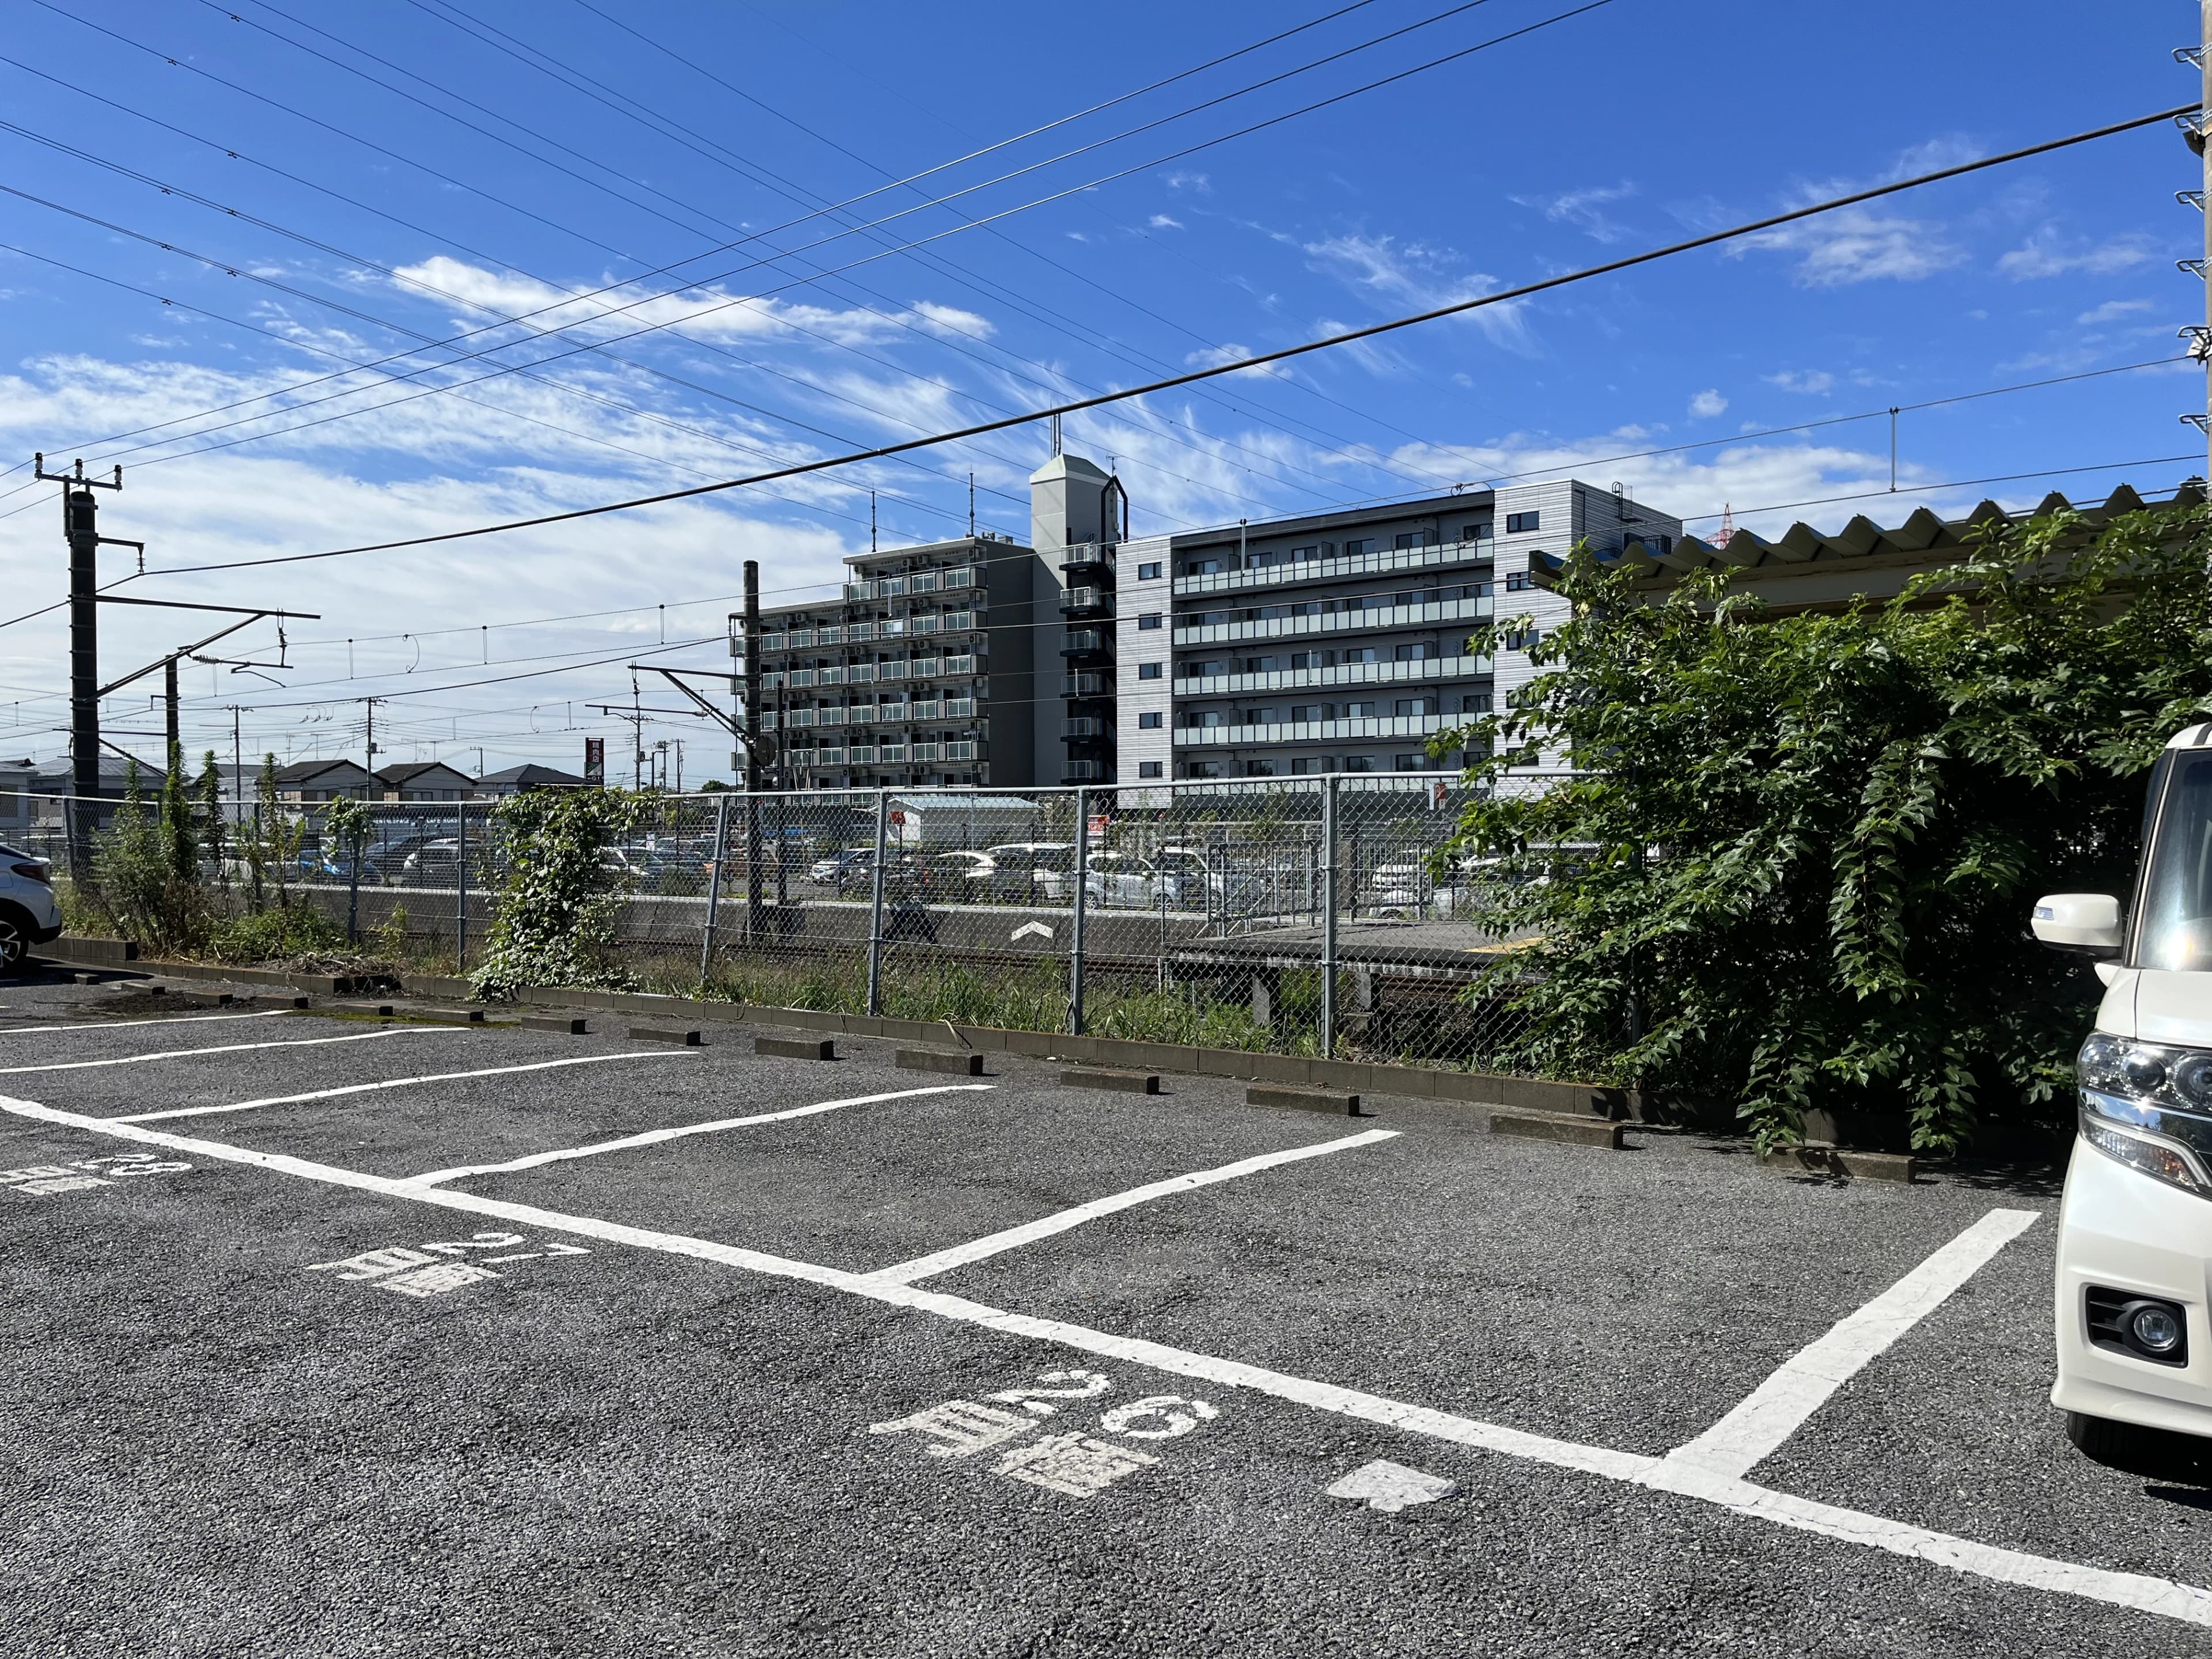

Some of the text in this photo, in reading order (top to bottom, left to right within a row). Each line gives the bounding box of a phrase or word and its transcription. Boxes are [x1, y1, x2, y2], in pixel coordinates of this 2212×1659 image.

[69, 1153, 193, 1176] 28
[307, 1247, 505, 1298] 月極
[420, 1232, 592, 1264] 27
[987, 1369, 1220, 1440] 26
[869, 1399, 1161, 1499] 月極
